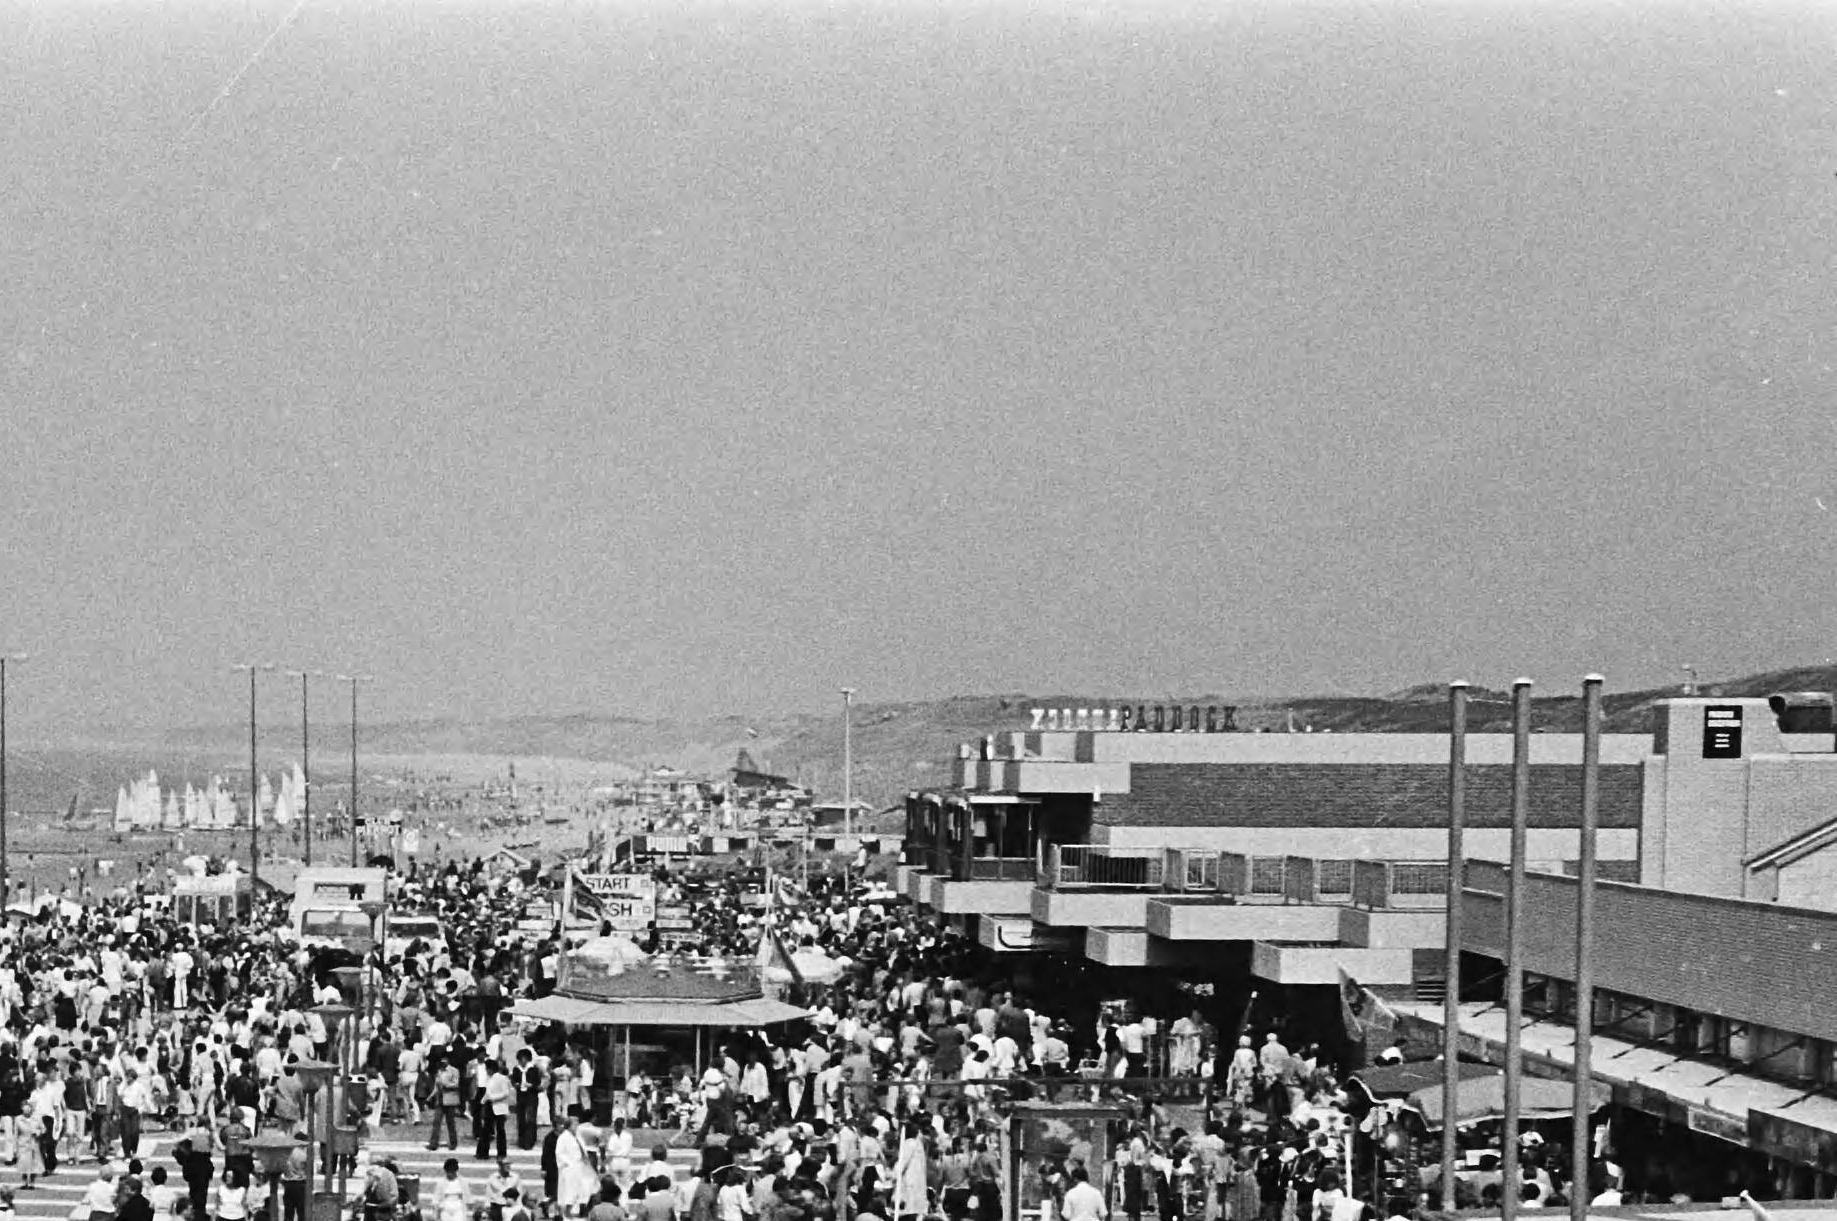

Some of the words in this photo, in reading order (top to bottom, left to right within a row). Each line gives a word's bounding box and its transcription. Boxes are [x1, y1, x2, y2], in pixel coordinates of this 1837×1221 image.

[1121, 705, 1237, 731] PADDOCK
[586, 877, 631, 889] START
[609, 902, 632, 916] SH
